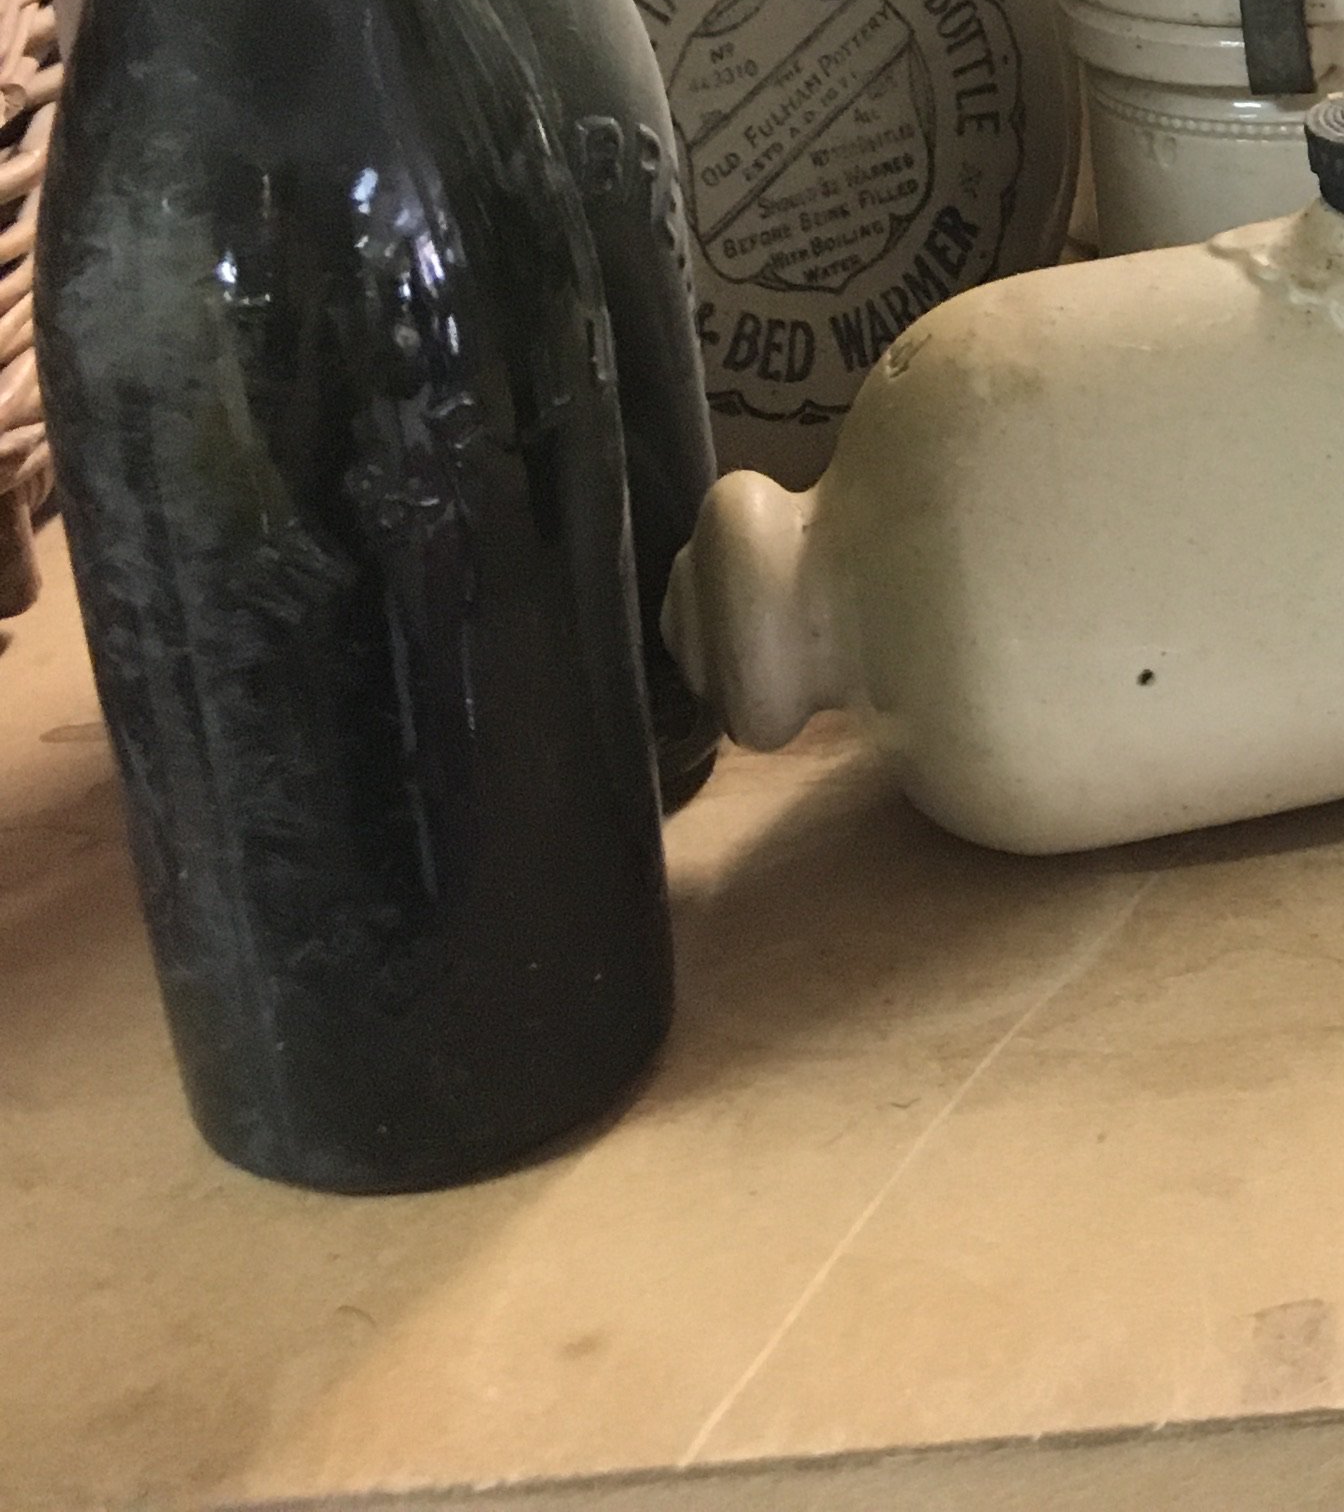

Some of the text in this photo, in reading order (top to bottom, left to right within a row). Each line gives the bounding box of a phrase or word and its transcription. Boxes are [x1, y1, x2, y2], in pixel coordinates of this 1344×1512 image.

[700, 152, 742, 188] OLD
[744, 73, 822, 148] FULHAM
[817, 6, 890, 77] POTTERY
[723, 311, 815, 383] BED
